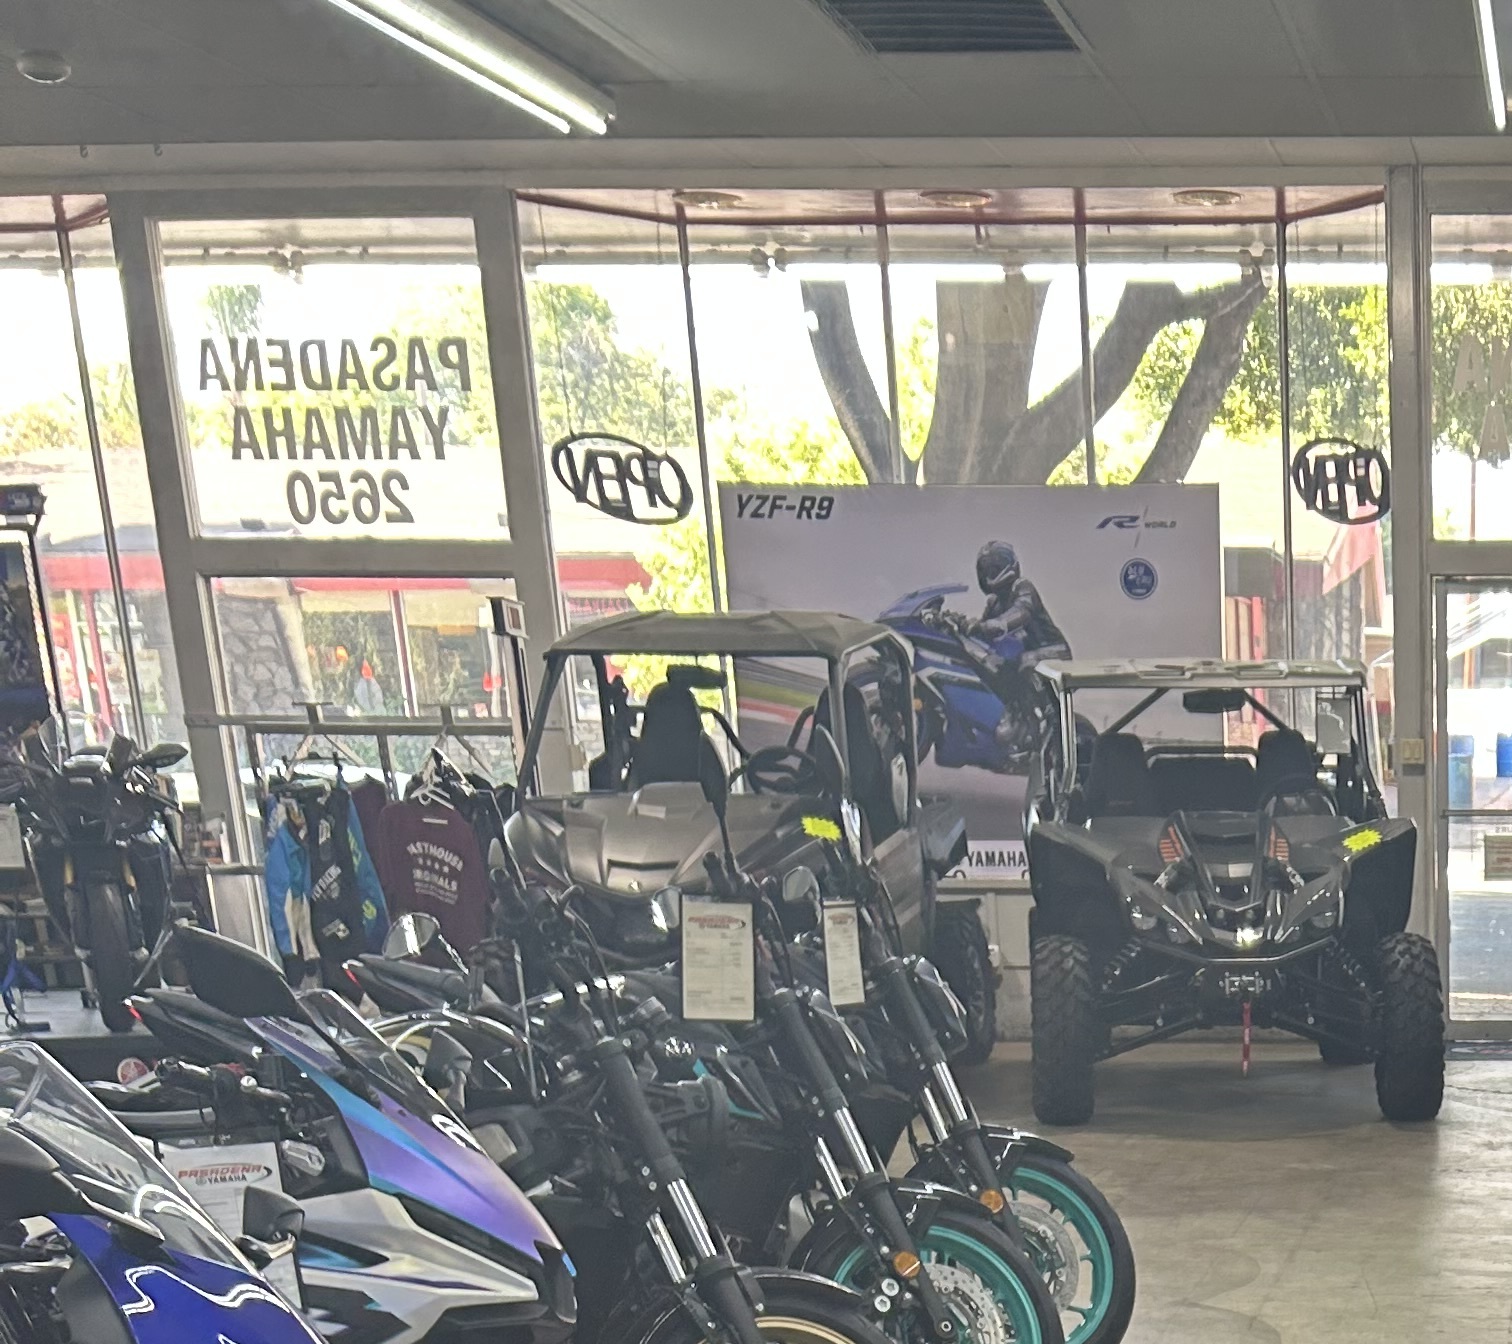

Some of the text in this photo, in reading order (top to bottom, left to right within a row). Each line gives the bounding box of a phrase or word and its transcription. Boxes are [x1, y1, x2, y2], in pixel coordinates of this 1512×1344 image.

[737, 494, 835, 520] YZF-R9
[966, 850, 1027, 868] YAMAHA
[178, 1164, 263, 1180] PASADENA
[207, 1174, 248, 1185] YAMAHA
